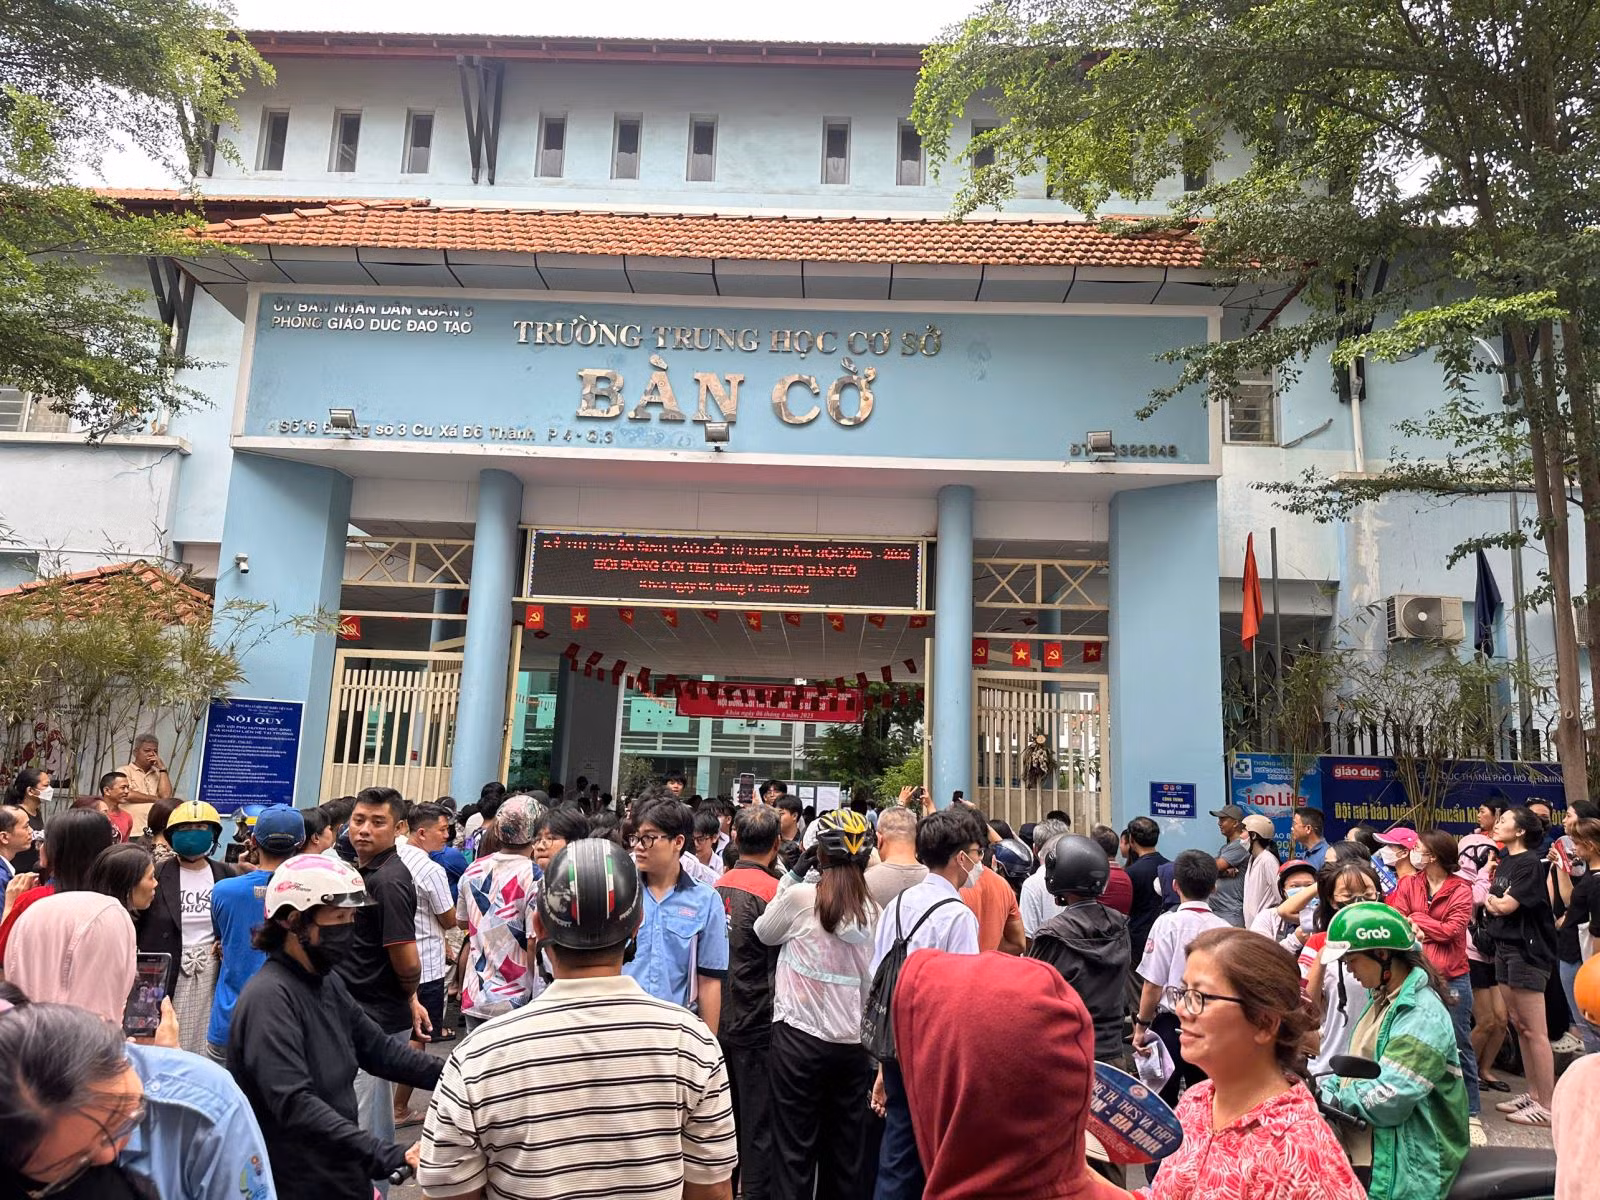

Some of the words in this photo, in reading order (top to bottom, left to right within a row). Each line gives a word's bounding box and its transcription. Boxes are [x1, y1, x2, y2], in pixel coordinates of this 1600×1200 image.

[298, 301, 330, 313] BAN
[335, 300, 377, 315] NHÂN
[328, 314, 365, 330] GIÁO
[443, 321, 473, 337] TẠO
[513, 314, 643, 348] TRƯỜNG
[652, 326, 760, 352] TRUNG
[769, 328, 838, 359] HỌC
[847, 327, 892, 356] CƠ
[901, 323, 942, 357] SỞ
[575, 353, 746, 425] BÀN
[772, 356, 877, 427] CỜ
[398, 423, 407, 437] 3
[439, 424, 458, 438] Xá
[782, 544, 813, 558] NĂM
[815, 546, 844, 560] HỌC
[593, 557, 619, 571] HỘI
[687, 561, 710, 574] THI
[712, 560, 768, 575] TRƯỜNG
[770, 563, 804, 577] THCS
[806, 563, 834, 577] BÀN
[254, 717, 284, 725] QUY
[1334, 765, 1359, 778] giáo
[1360, 767, 1380, 779] dục
[1335, 801, 1351, 823] Đội
[1353, 802, 1368, 820] mũ
[1370, 801, 1388, 820] bảo
[1355, 925, 1391, 939] Grab
[1117, 1099, 1142, 1120] THCS
[1151, 1126, 1176, 1145] THPT
